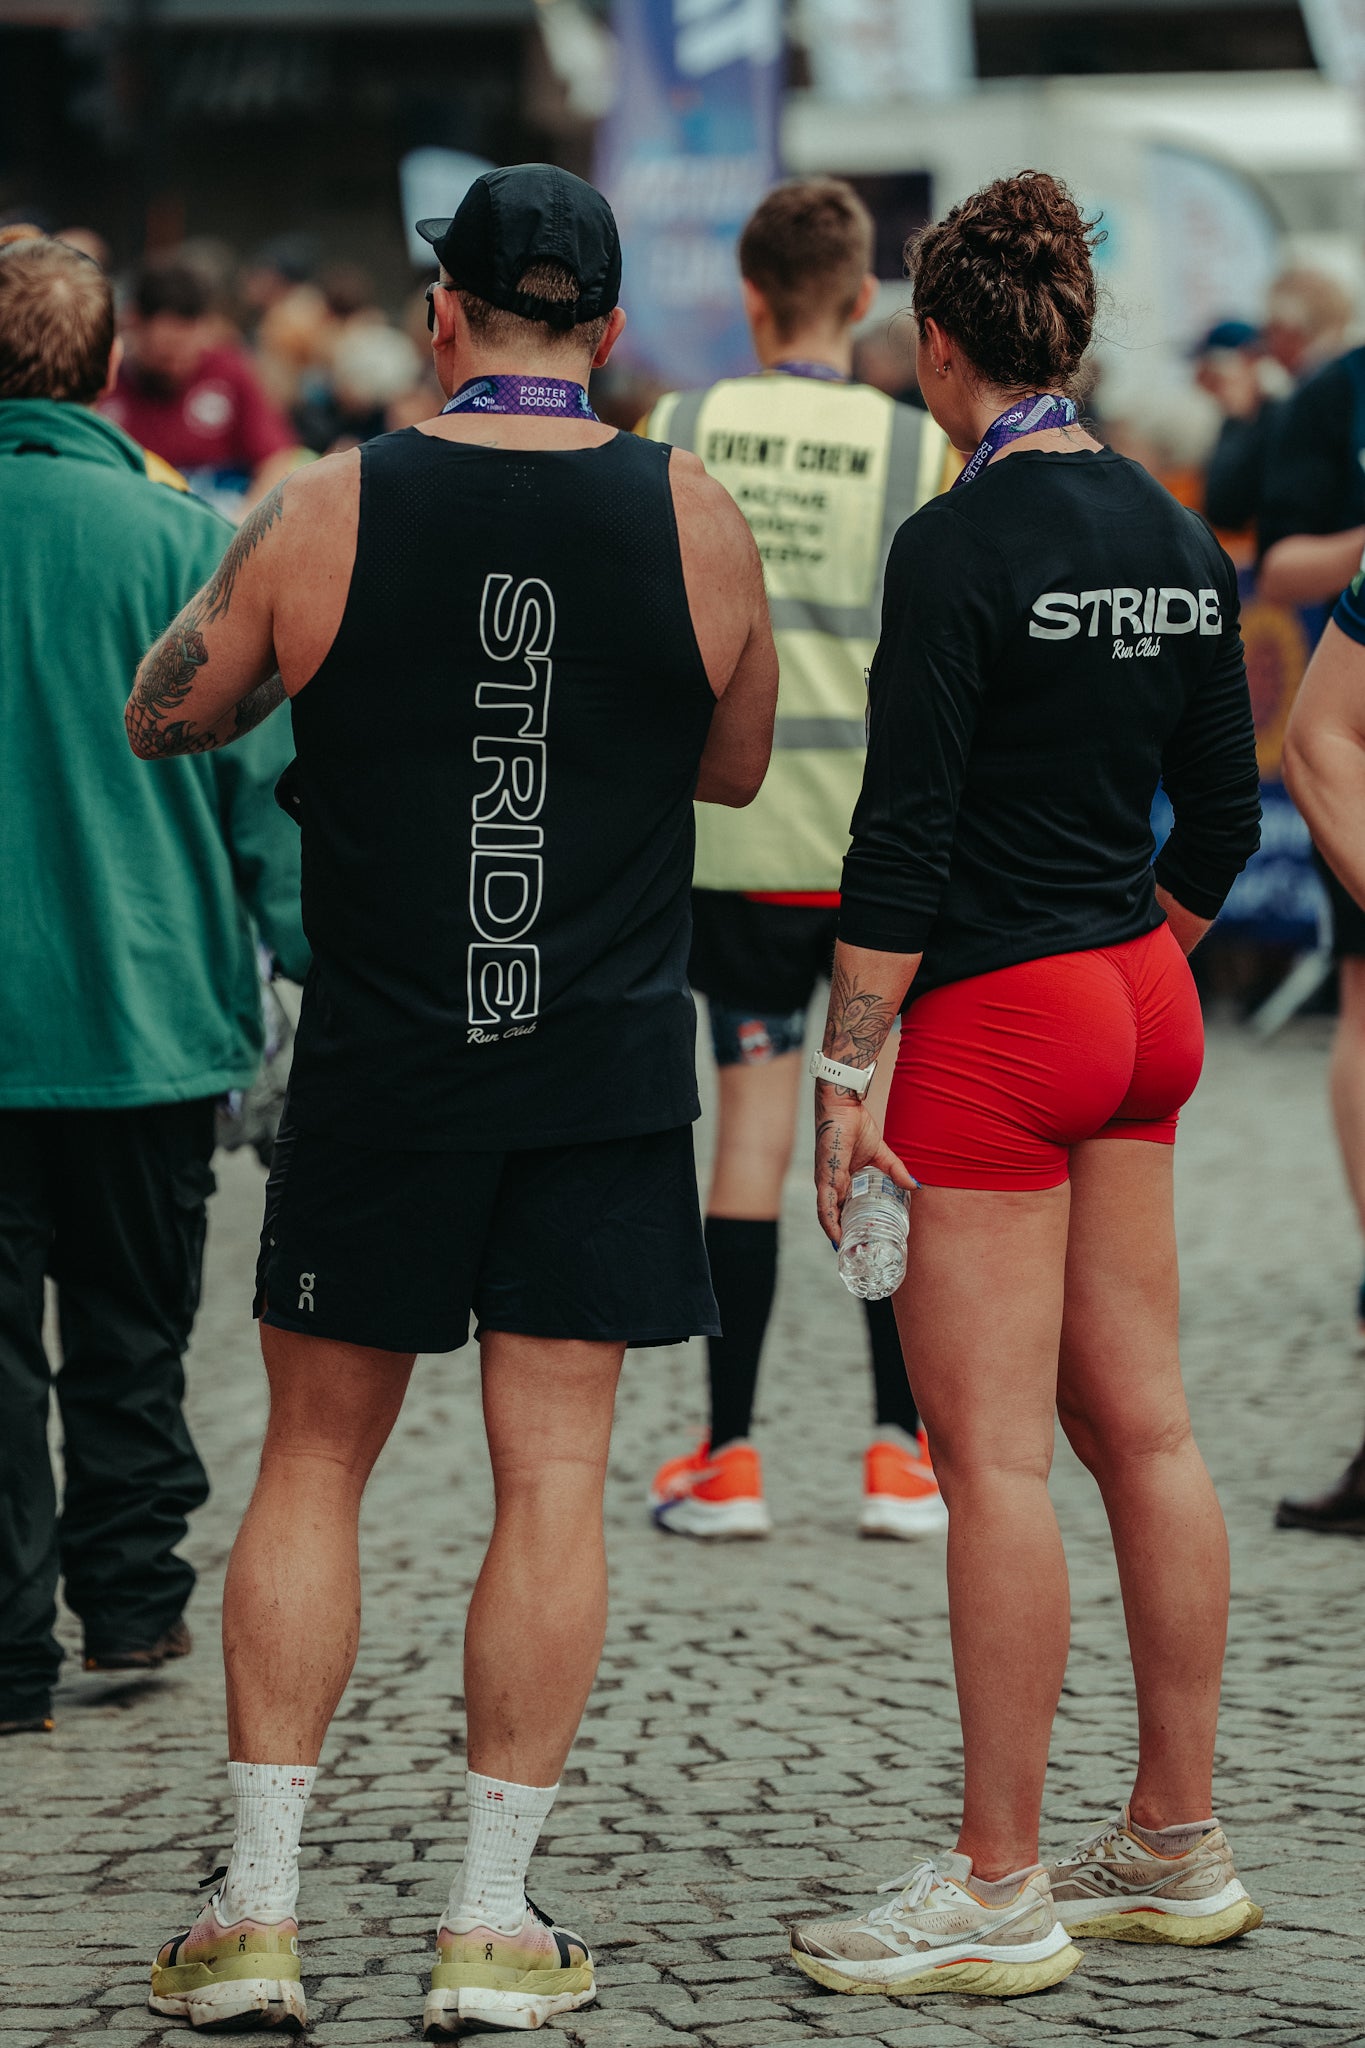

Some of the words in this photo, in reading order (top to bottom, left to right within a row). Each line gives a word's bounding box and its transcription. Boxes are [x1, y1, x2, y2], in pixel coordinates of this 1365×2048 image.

[472, 396, 495, 407] 40th
[519, 396, 567, 408] DODSON
[520, 386, 567, 398] PORTER
[1003, 411, 1024, 426] 40th
[706, 431, 786, 466] EVENT
[797, 439, 870, 476] CREW
[1029, 587, 1223, 640] STRIDE
[1112, 637, 1134, 660] Run
[1135, 636, 1161, 658] Club
[466, 573, 556, 1025] STRIDE
[466, 1027, 500, 1044] Run
[503, 1021, 538, 1038] Club
